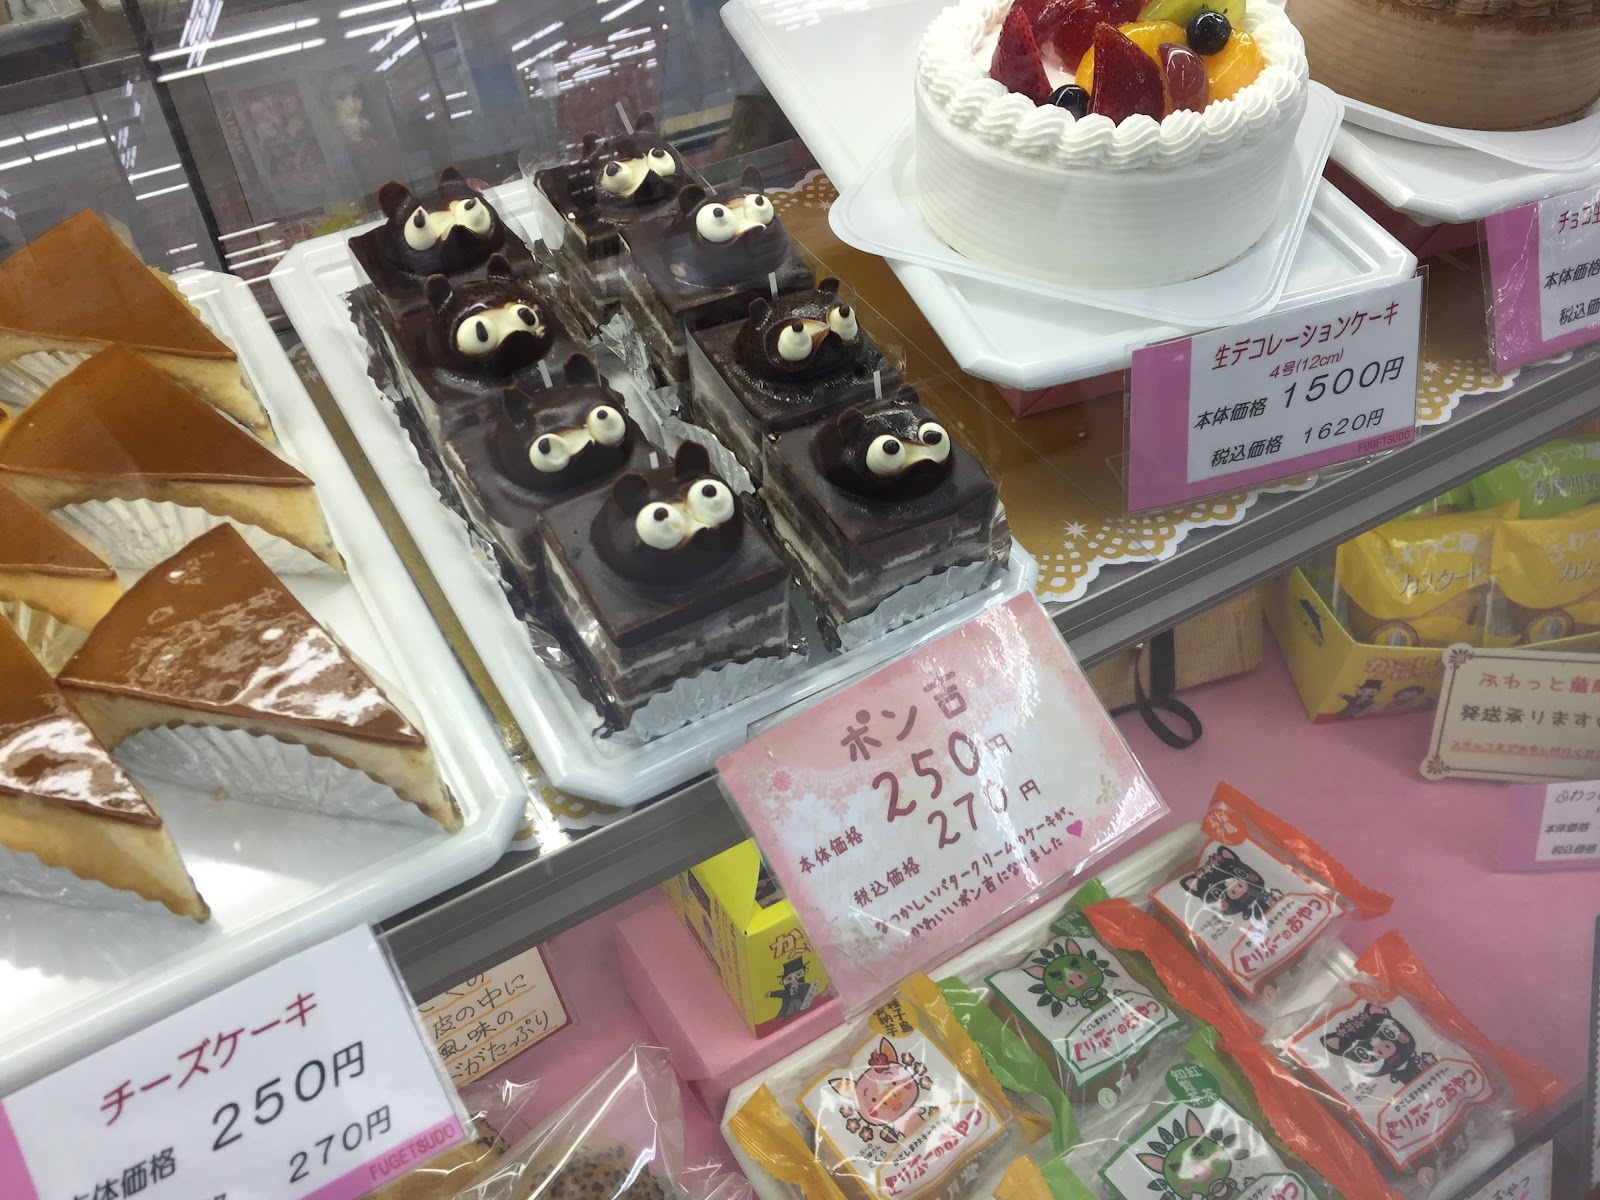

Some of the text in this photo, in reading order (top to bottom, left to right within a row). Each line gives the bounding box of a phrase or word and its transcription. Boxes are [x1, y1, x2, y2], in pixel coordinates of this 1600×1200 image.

[1211, 301, 1399, 371] 生デコレーションケーキ
[1194, 356, 1405, 430] 本体価格 1500円
[1210, 407, 1385, 468] 税込価格 1620円
[1358, 429, 1411, 453] FUGETSUDO
[840, 671, 968, 762] ポン吉
[799, 826, 864, 876] 本体価格
[1545, 821, 1591, 835] 本体価格
[853, 856, 922, 908] 税込価格
[100, 992, 318, 1127] チーズケーキ
[438, 1010, 514, 1061] 風味の
[73, 1040, 365, 1200] 体価格 250円
[289, 1105, 391, 1184] 270円
[369, 1124, 456, 1182] FUGETSUDO
